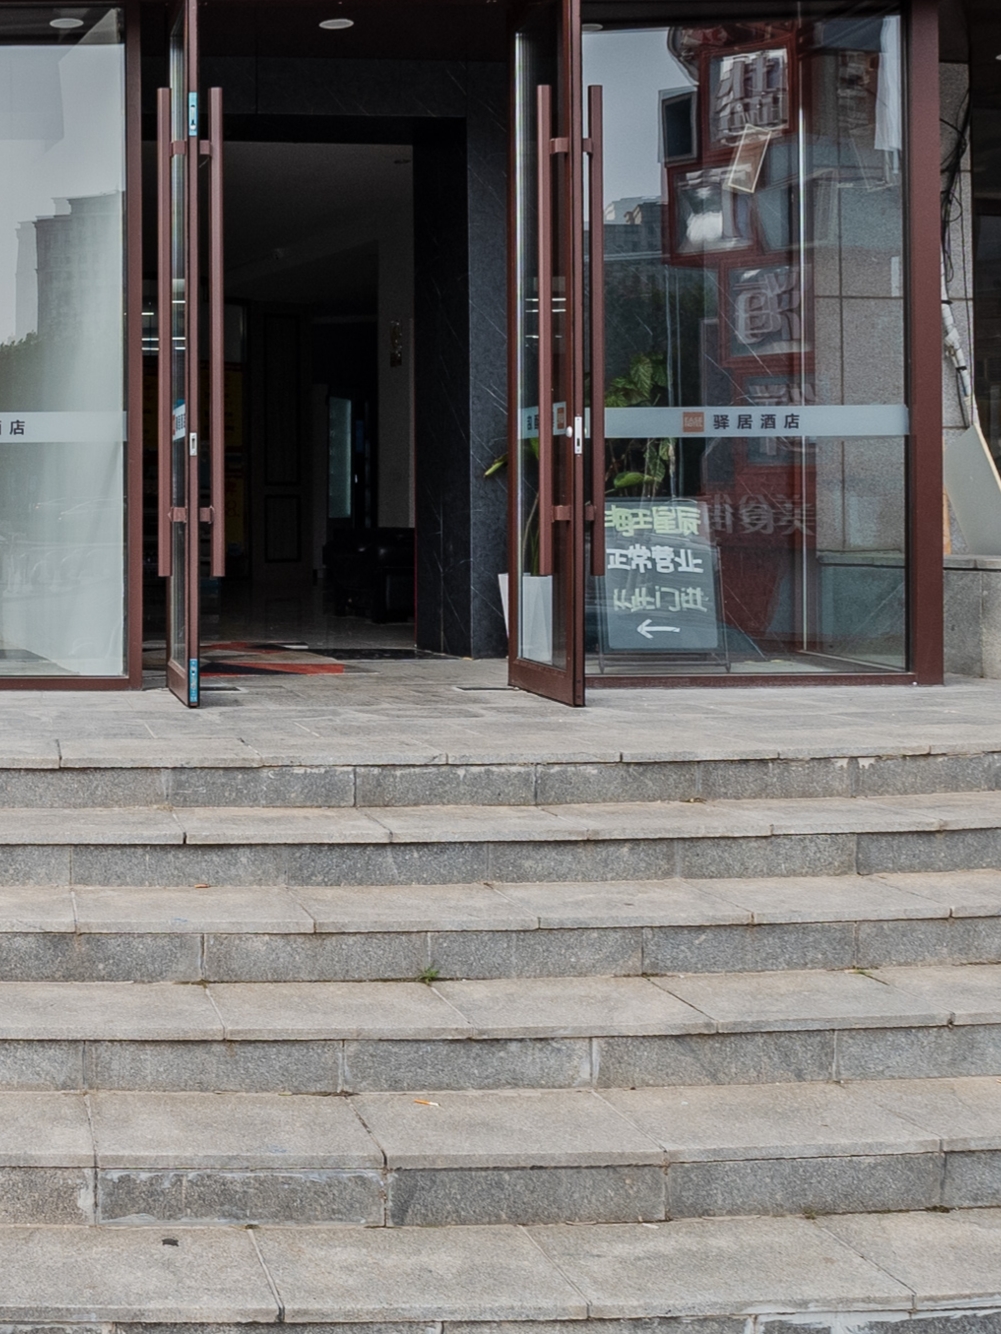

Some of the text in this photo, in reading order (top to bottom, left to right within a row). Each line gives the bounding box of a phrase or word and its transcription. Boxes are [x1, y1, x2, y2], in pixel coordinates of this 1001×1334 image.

[713, 413, 800, 429] 驿居酒店
[606, 543, 704, 573] 正常营业
